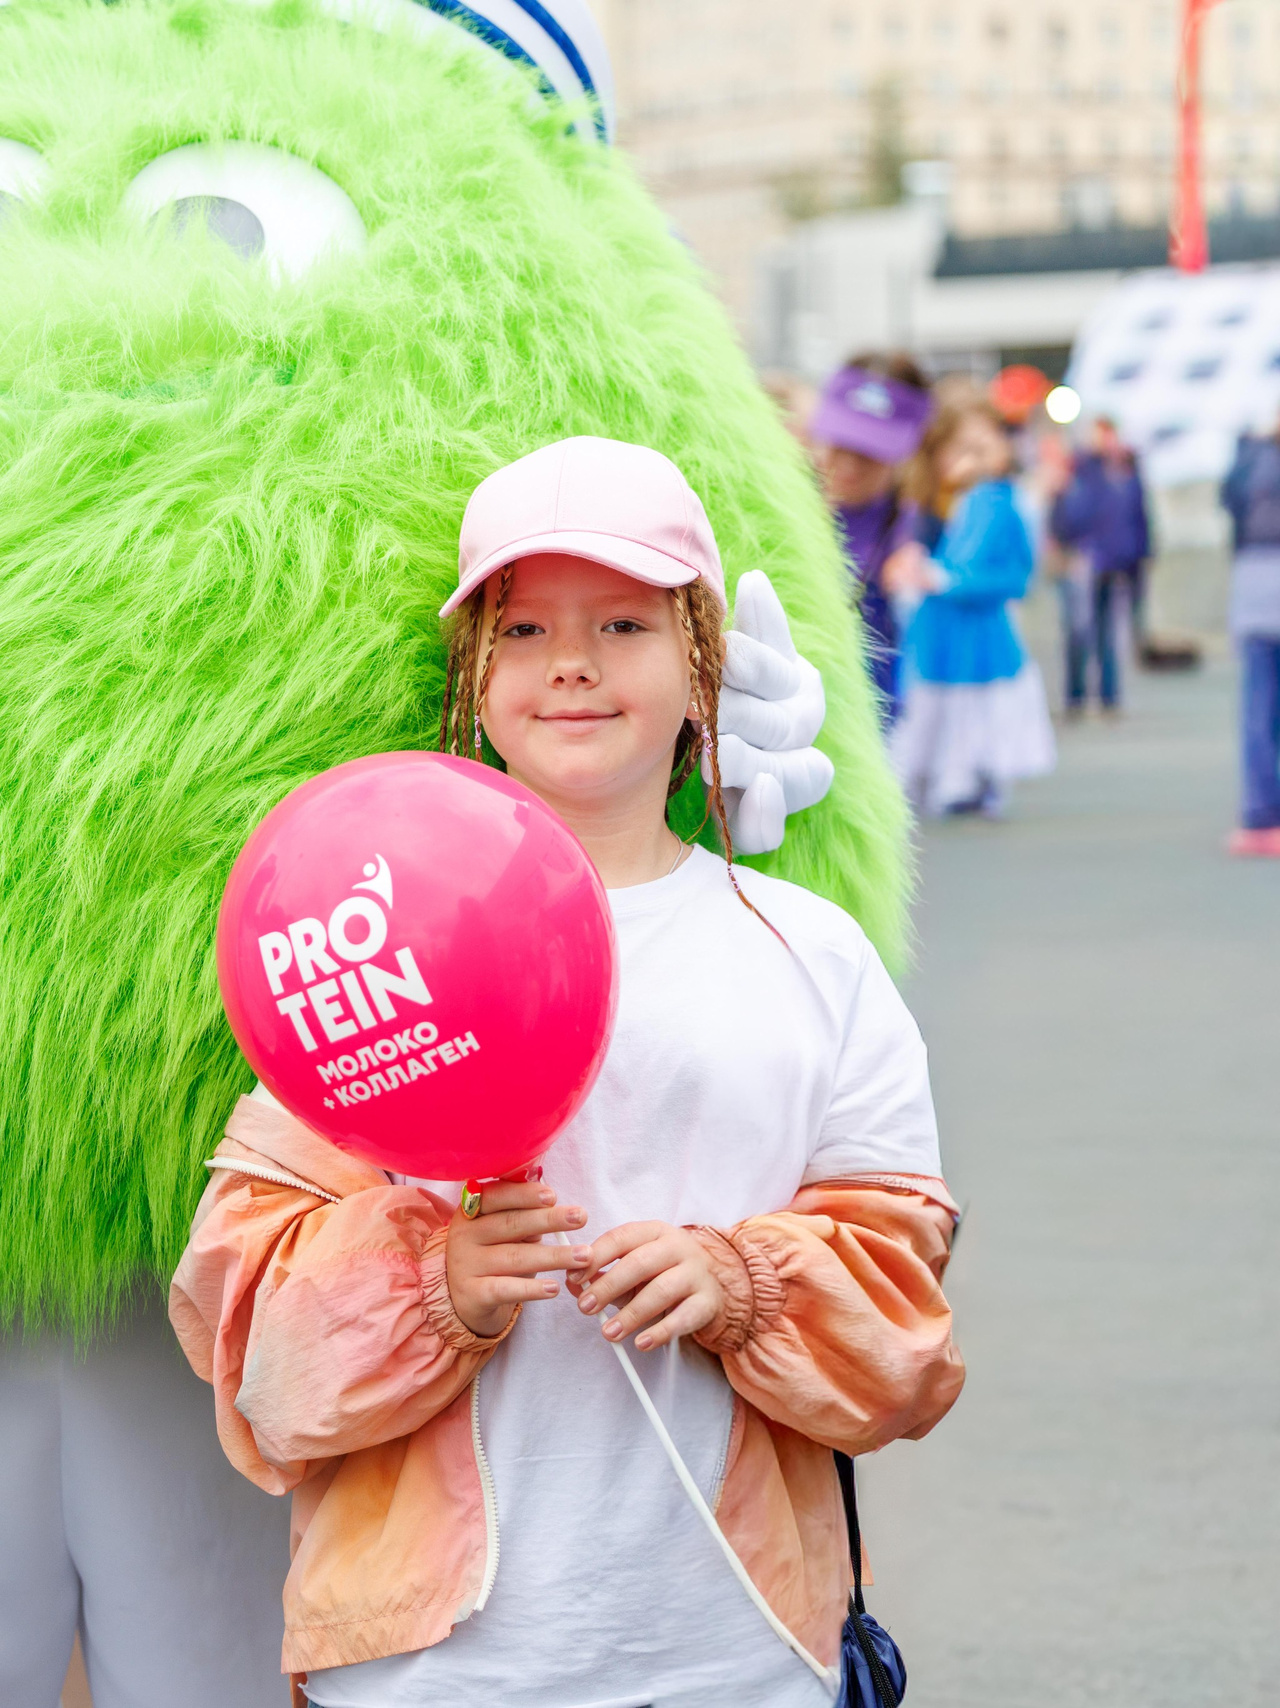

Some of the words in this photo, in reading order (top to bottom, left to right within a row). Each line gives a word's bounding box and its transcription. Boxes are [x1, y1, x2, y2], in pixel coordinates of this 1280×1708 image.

[257, 895, 389, 997] PRO
[275, 945, 434, 1053] TEIN
[315, 1020, 440, 1086] МОЛОКО
